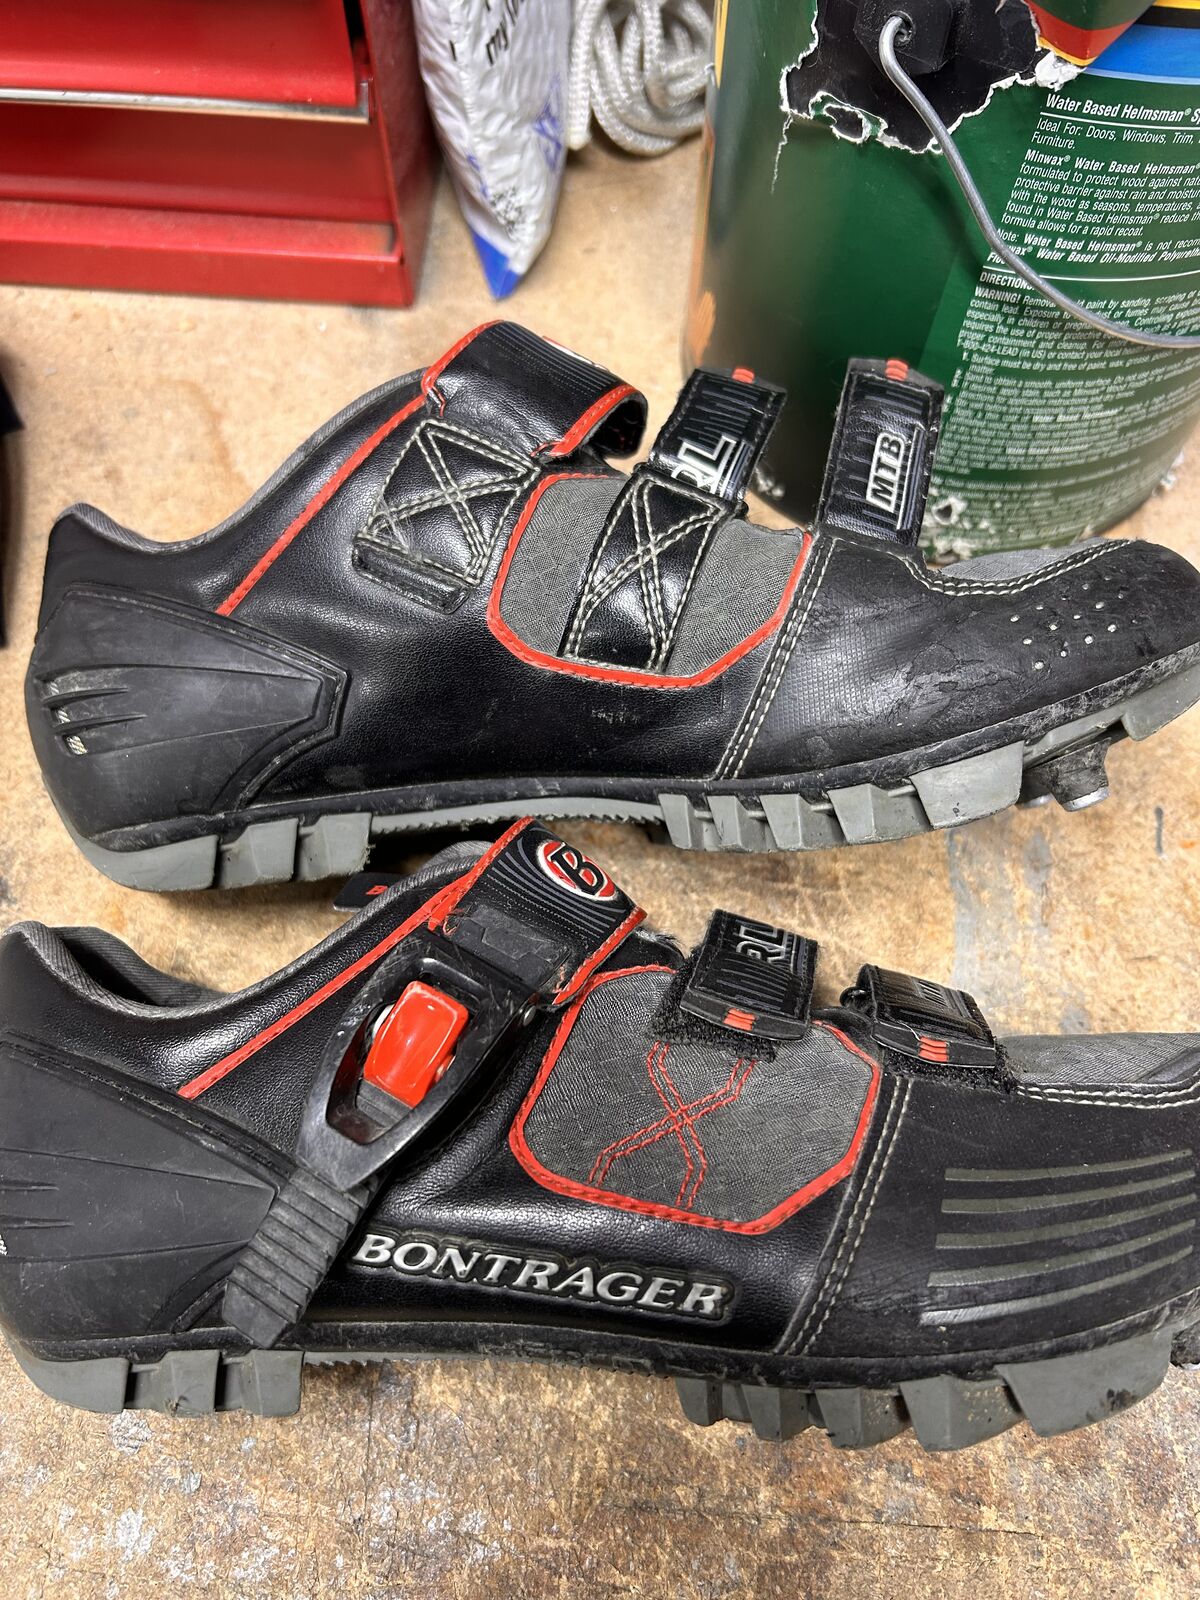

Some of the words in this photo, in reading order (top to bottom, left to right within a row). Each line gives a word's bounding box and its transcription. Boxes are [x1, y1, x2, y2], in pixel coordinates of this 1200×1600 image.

[1046, 93, 1081, 112] Water
[1083, 100, 1121, 117] Based
[1031, 131, 1076, 149] Furniture.
[1037, 118, 1061, 132] Ideal
[1063, 122, 1083, 136] For:
[1086, 125, 1117, 141] Doors,
[1122, 130, 1167, 144] Windows,
[1173, 132, 1194, 144] Trim,
[1019, 162, 1071, 180] formulated
[1073, 171, 1083, 182] to
[1083, 174, 1119, 188] protect
[1121, 176, 1148, 187] wood
[1149, 176, 1182, 189] against
[1074, 157, 1105, 171] Water
[1108, 161, 1141, 174] Based
[1014, 177, 1060, 193] protective
[1061, 183, 1094, 197] barrier
[1094, 188, 1128, 200] against
[1129, 190, 1147, 200] rain
[1148, 189, 1167, 200] and
[1006, 200, 1033, 215] found
[1034, 206, 1044, 216] in
[1047, 207, 1074, 221] Water
[1075, 211, 1105, 223] Based
[1160, 213, 1190, 223] reduce
[1010, 189, 1031, 202] with
[1033, 192, 1048, 204] the
[1050, 197, 1078, 208] wood
[1078, 199, 1090, 210] as
[1092, 200, 1131, 213] seasons,
[1135, 201, 1193, 214] temperatures,
[1001, 212, 1036, 228] formula
[1037, 220, 1067, 232] allows
[1068, 222, 1082, 234] for
[1082, 227, 1089, 235] a
[1090, 225, 1115, 237] rapid
[1114, 226, 1144, 237] recoat.
[1024, 233, 1052, 247] Water
[1055, 237, 1084, 251] Based
[1144, 240, 1153, 251] is
[1156, 239, 1172, 251] not
[1036, 248, 1066, 261] Water
[1067, 252, 1098, 263] Based
[970, 299, 999, 311] contain
[1023, 306, 1060, 319] Exposure
[1125, 308, 1149, 318] fumes
[974, 286, 1021, 304] WARNING!
[1085, 299, 1107, 309] paint
[1108, 299, 1119, 310] by
[966, 310, 1004, 325] especially
[1006, 316, 1015, 325] in
[1017, 317, 1049, 329] children
[868, 434, 903, 509] MTB
[546, 842, 608, 897] B
[353, 1233, 726, 1315] BONTRAGER
